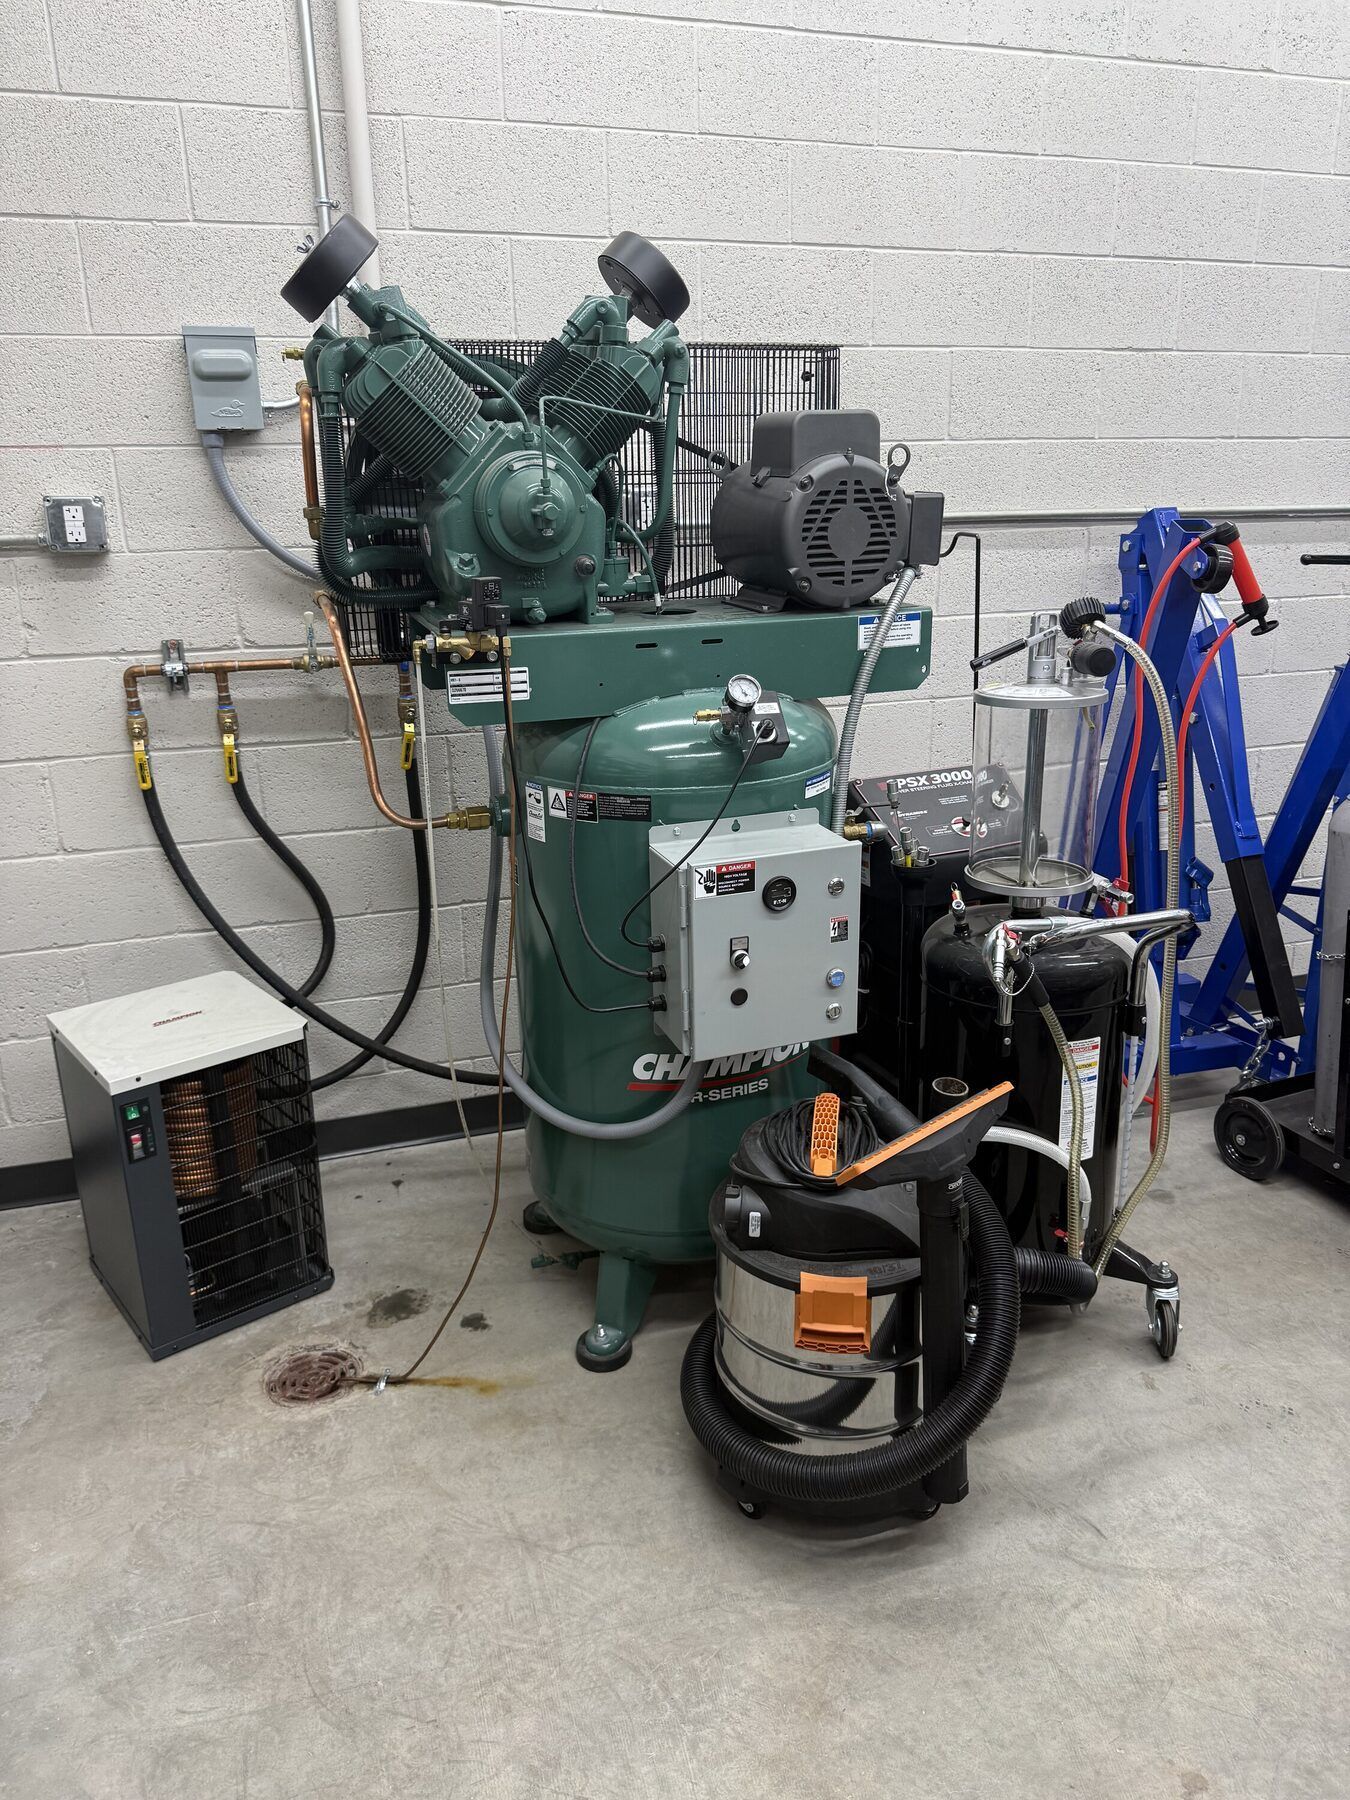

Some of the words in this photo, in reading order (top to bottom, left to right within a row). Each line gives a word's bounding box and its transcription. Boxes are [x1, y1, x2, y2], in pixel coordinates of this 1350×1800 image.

[897, 775, 929, 789] PSX
[931, 769, 972, 785] 3000
[911, 784, 937, 792] STEERING
[728, 863, 752, 872] DANGER
[691, 1078, 769, 1103] R-SERIES
